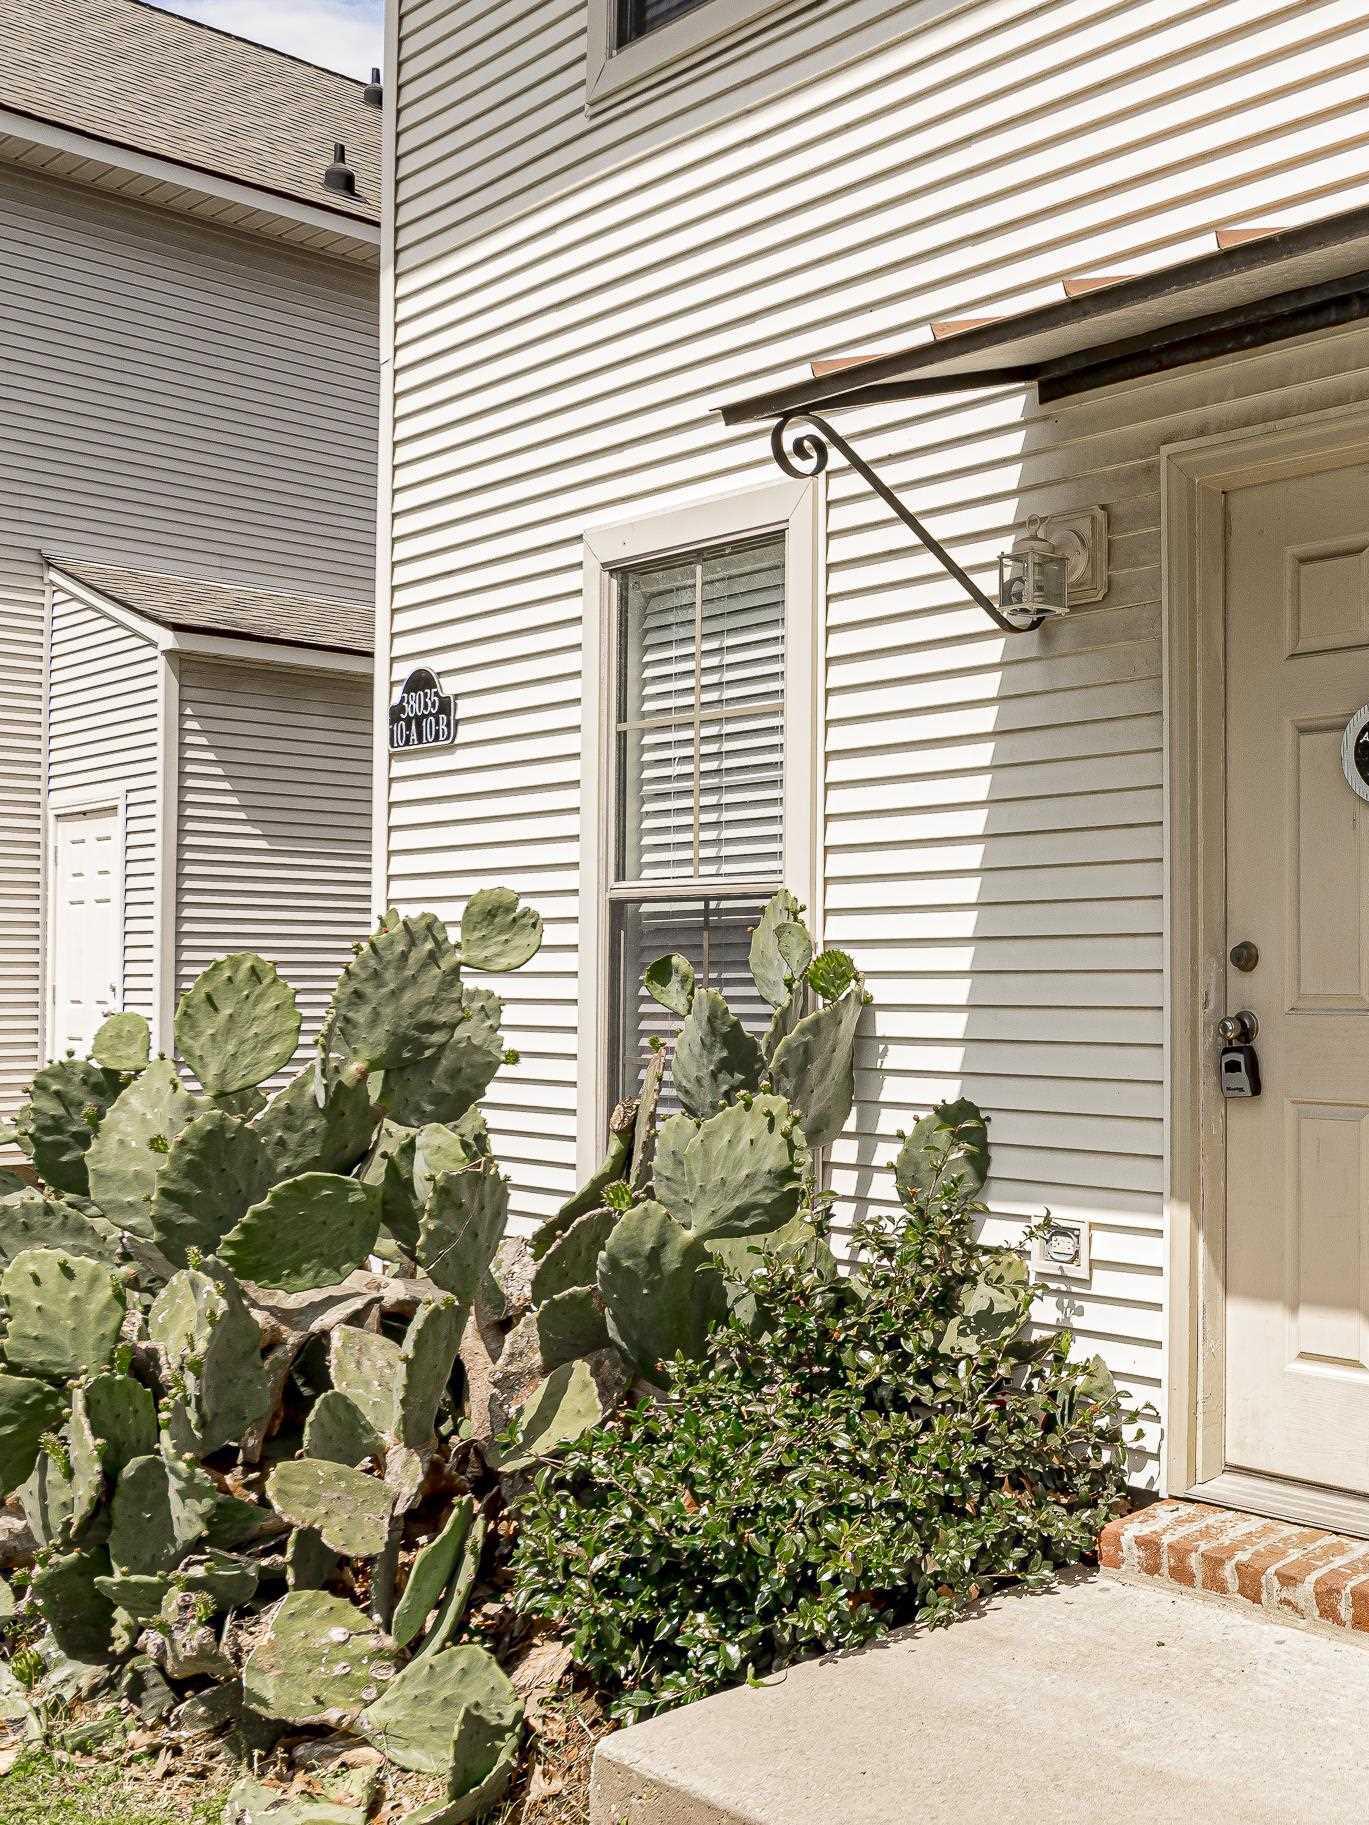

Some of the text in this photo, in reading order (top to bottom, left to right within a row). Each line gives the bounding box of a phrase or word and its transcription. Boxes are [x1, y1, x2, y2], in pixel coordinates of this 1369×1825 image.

[400, 689, 440, 718] 38035
[393, 714, 448, 747] 10-A 10-B
